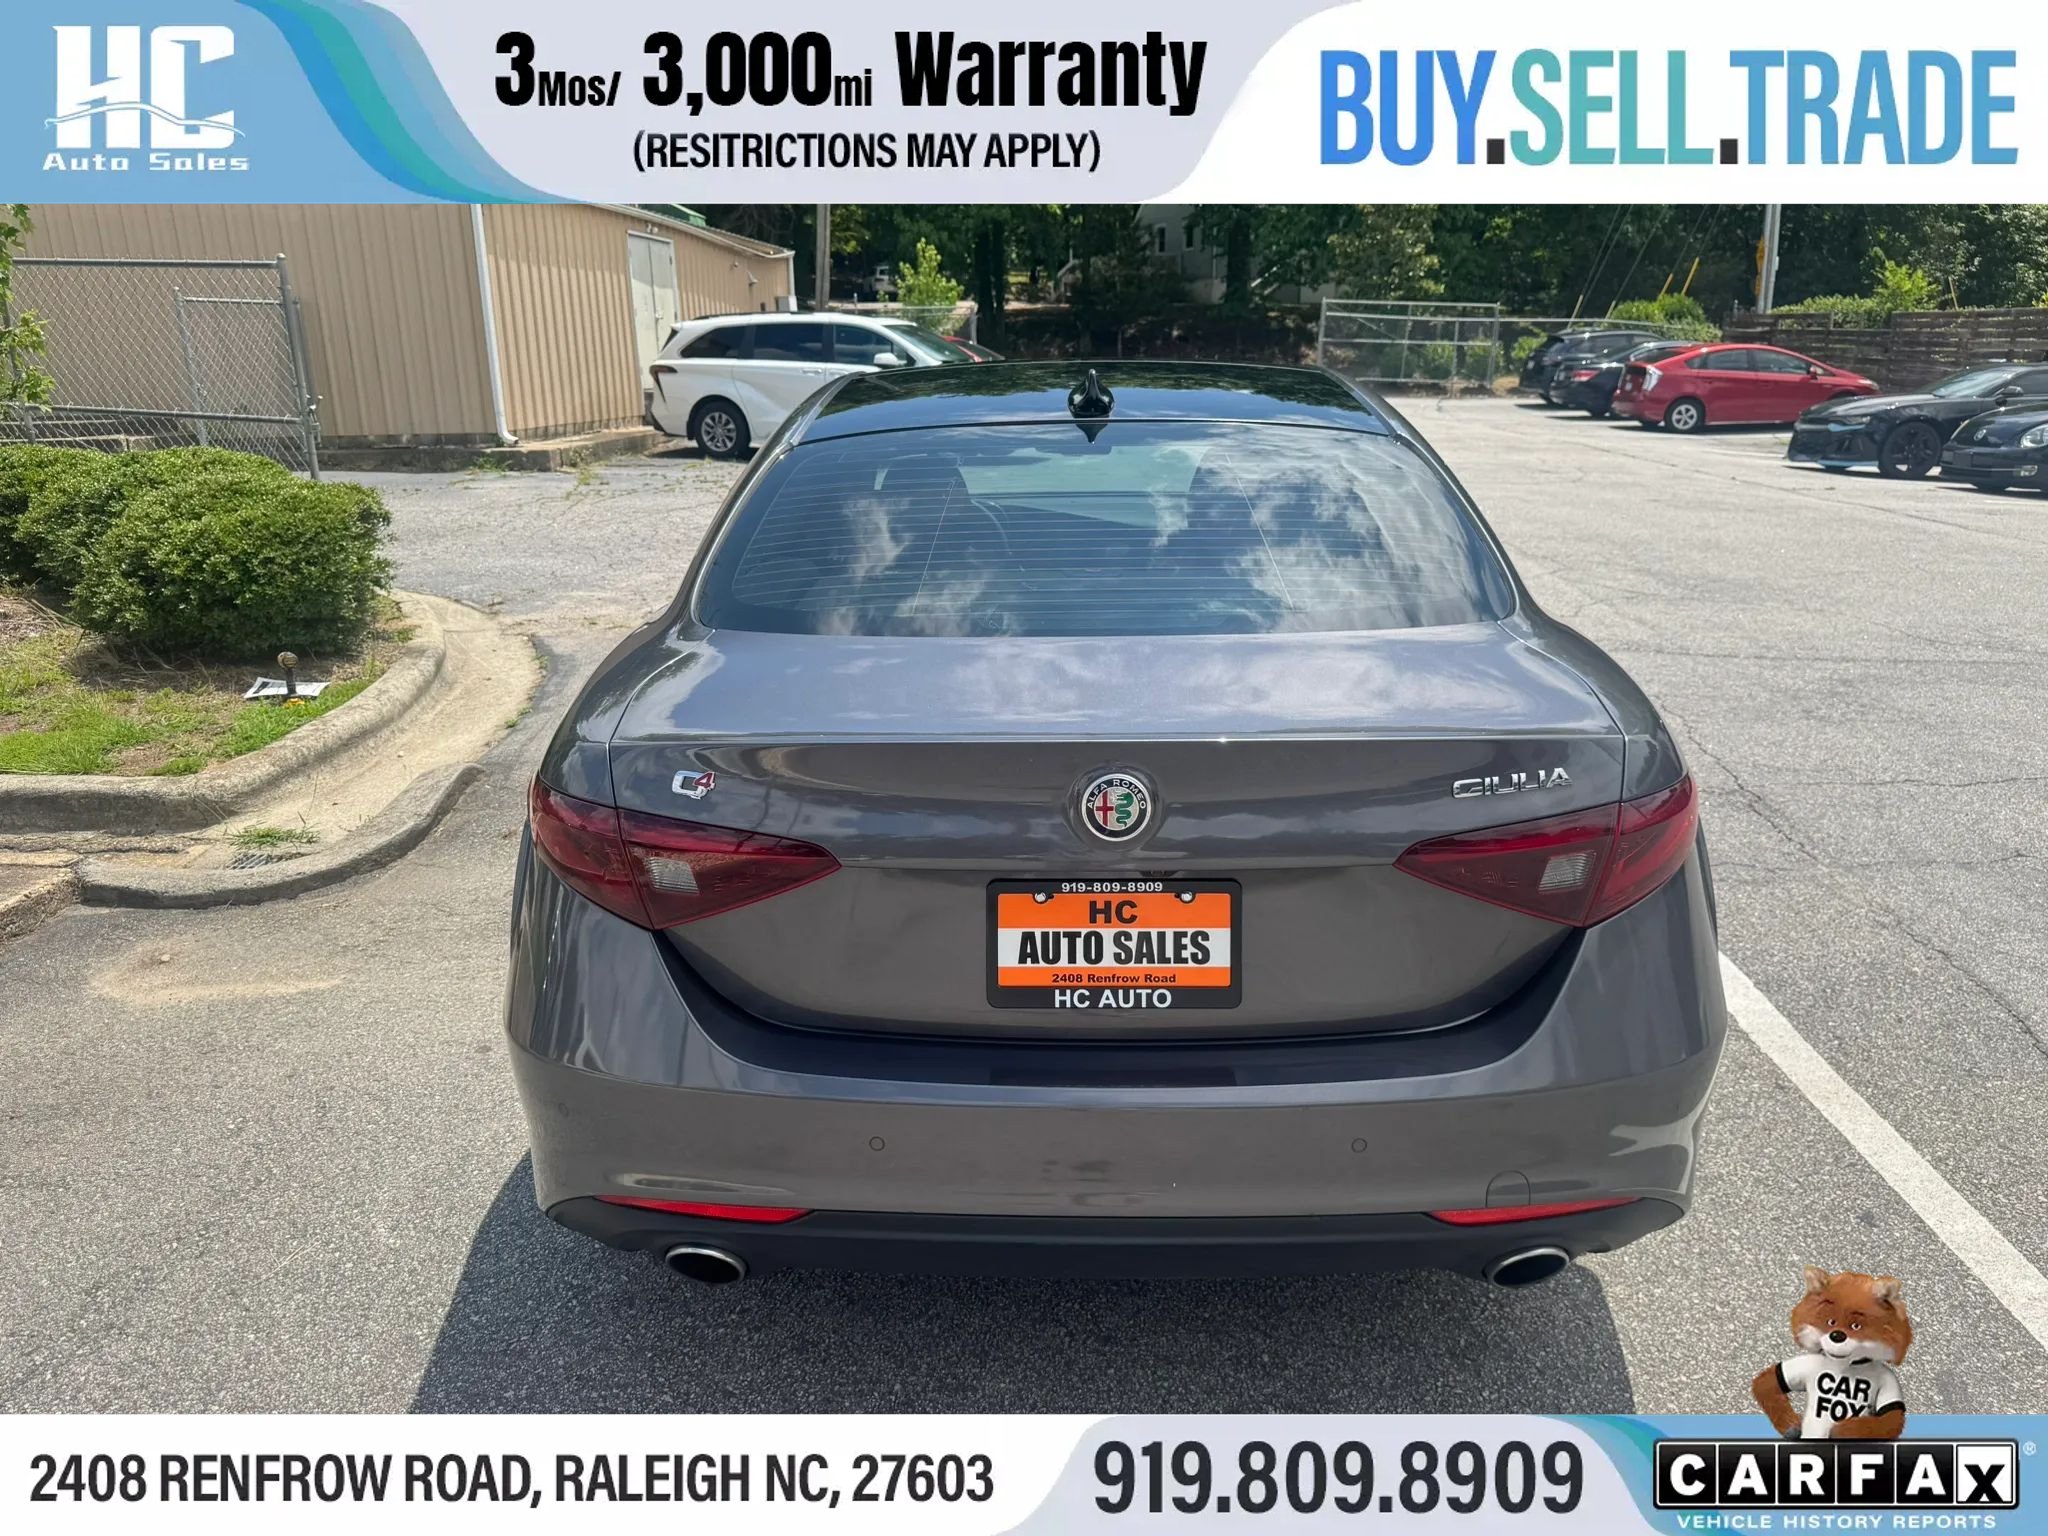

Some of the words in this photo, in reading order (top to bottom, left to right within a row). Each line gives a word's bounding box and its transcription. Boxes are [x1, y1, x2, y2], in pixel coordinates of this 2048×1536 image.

[1087, 782, 1108, 809] ALFA
[1112, 779, 1147, 809] ROMEO
[1452, 767, 1573, 799] GIULIA
[1061, 882, 1163, 893] 919-809-8909
[1089, 900, 1138, 924] HC
[1018, 931, 1104, 965] AUTO
[1112, 930, 1211, 965] SALES
[1052, 973, 1083, 984] 2408
[1087, 973, 1140, 984] Renfrow
[1144, 973, 1176, 984] Road
[1054, 989, 1090, 1008] HC
[1098, 989, 1172, 1009] AUTO
